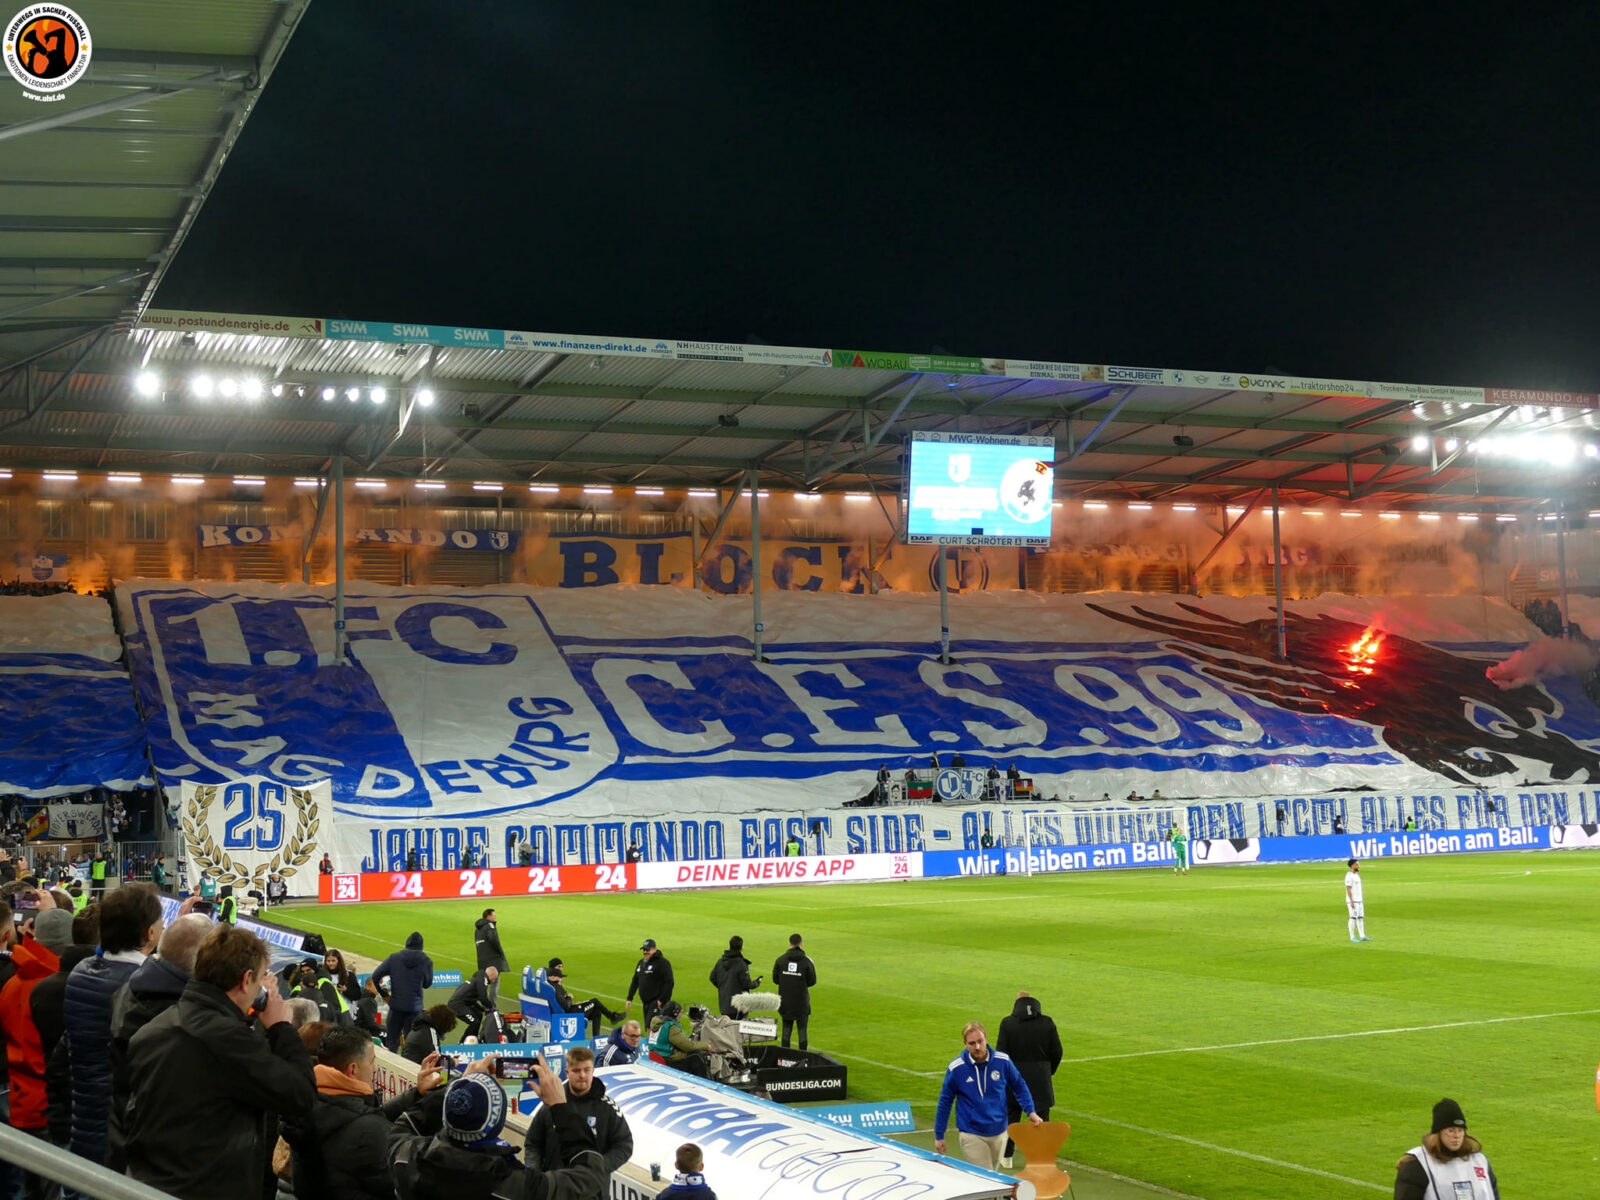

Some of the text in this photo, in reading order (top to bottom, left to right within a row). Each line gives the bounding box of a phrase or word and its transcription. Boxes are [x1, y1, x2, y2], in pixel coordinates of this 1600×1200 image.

[141, 315, 290, 332] www.postundenergie.de
[330, 321, 367, 334] SWM
[393, 324, 429, 338] SWM
[454, 328, 490, 341] SWM
[533, 340, 647, 353] www.finanzen-direkt.de
[865, 358, 907, 370] WOBAU
[1108, 366, 1163, 381] SCHUBERT
[1431, 387, 1449, 395] GmbH
[949, 434, 1021, 446] MWG-Wohnen.de
[939, 536, 1013, 546] CURT SCHRÖTER
[559, 541, 893, 595] BLOCK
[592, 657, 1265, 747] C.E.S.99
[188, 693, 590, 799] MAGDEBURG
[224, 781, 287, 851] 25
[361, 827, 488, 873] JAHRE
[739, 816, 832, 859] EAST
[846, 814, 925, 854] SIDE
[1187, 802, 1247, 841] DEN
[1361, 795, 1447, 833] ALLES
[1517, 792, 1570, 827] DEN
[1350, 826, 1539, 858] Wir bleiben am Ball.
[894, 862, 908, 874] 24
[958, 854, 1000, 875] Wir
[1005, 847, 1087, 874] bleiben
[1093, 849, 1126, 867] am
[595, 865, 627, 890] 24
[677, 859, 855, 883] DEINE NEWS APP
[337, 876, 355, 886] TAG
[390, 873, 423, 898] 24
[460, 870, 493, 896] 24
[528, 867, 560, 893] 24
[337, 887, 356, 898] 24
[482, 1048, 524, 1057] mhkw
[765, 1079, 842, 1091] BUNDESLIGA.COM
[860, 1109, 909, 1122] mhkw
